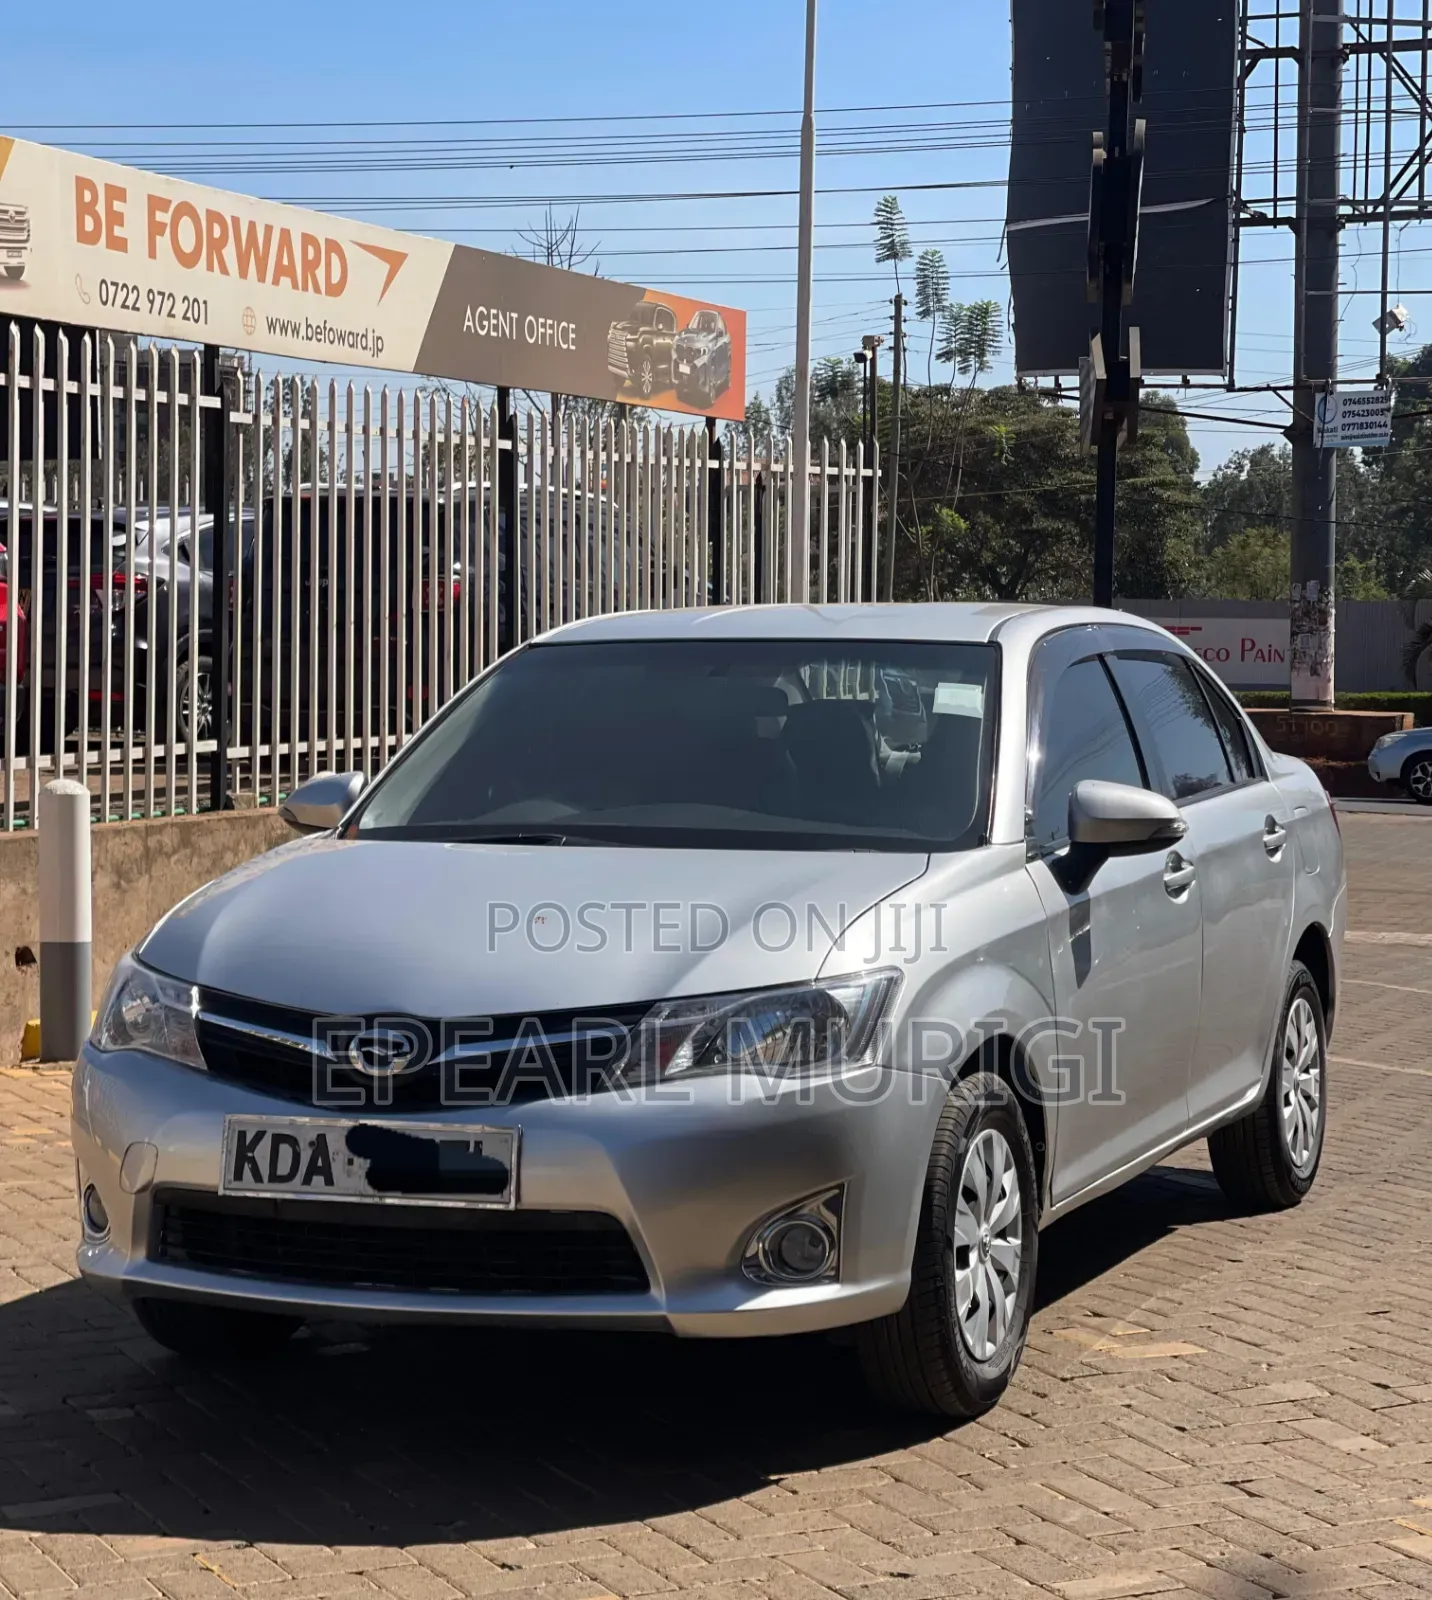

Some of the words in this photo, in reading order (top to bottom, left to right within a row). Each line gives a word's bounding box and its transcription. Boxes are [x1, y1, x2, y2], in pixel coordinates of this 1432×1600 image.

[75, 175, 128, 254] BE
[147, 193, 348, 298] FORWARD
[99, 278, 140, 312] 0722
[147, 289, 176, 319] 972
[181, 297, 209, 325] 201
[266, 315, 384, 359] www.befoward.jp
[463, 304, 518, 340] AGENT
[524, 315, 576, 350] OFFICE
[232, 1129, 335, 1187] KDA
